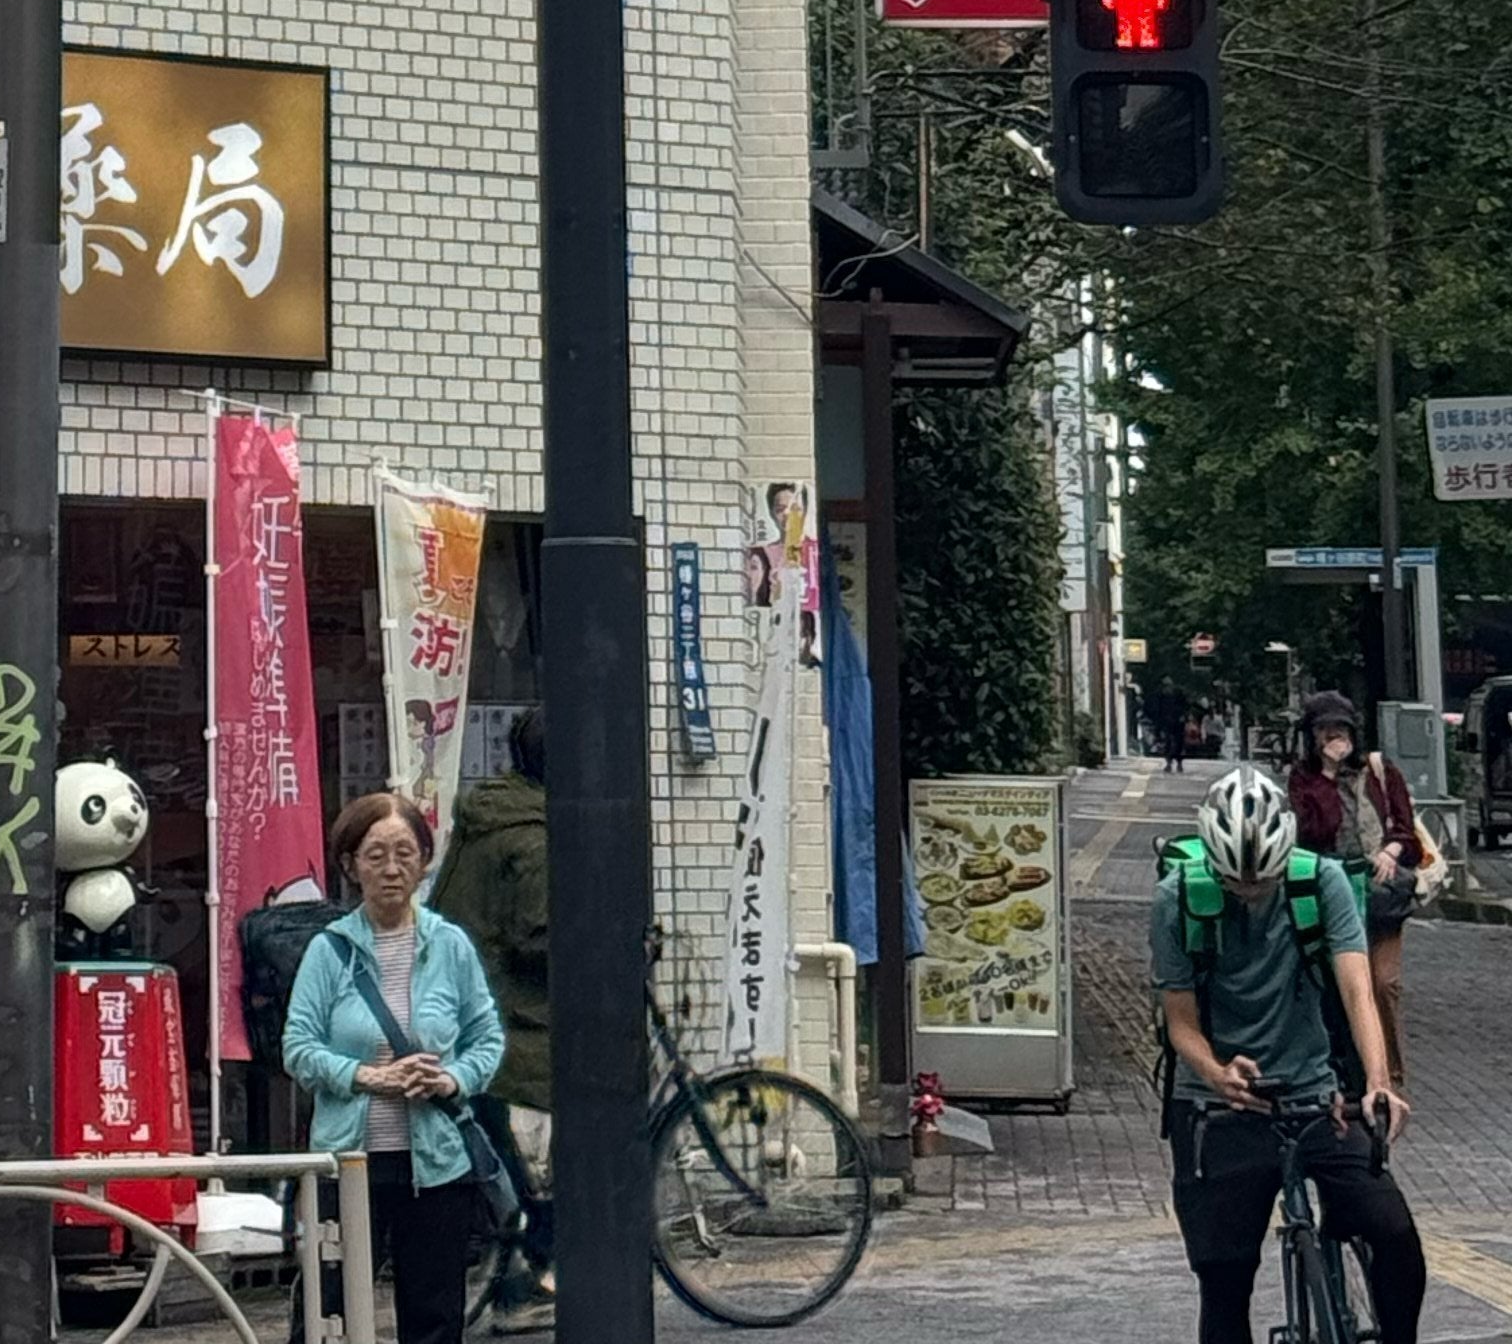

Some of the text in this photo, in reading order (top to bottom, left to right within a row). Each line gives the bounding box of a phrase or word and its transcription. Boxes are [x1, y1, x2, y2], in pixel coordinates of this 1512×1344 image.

[83, 634, 181, 662] ストレス
[682, 688, 705, 711] 31
[97, 989, 131, 1128] 冠元顆粒
